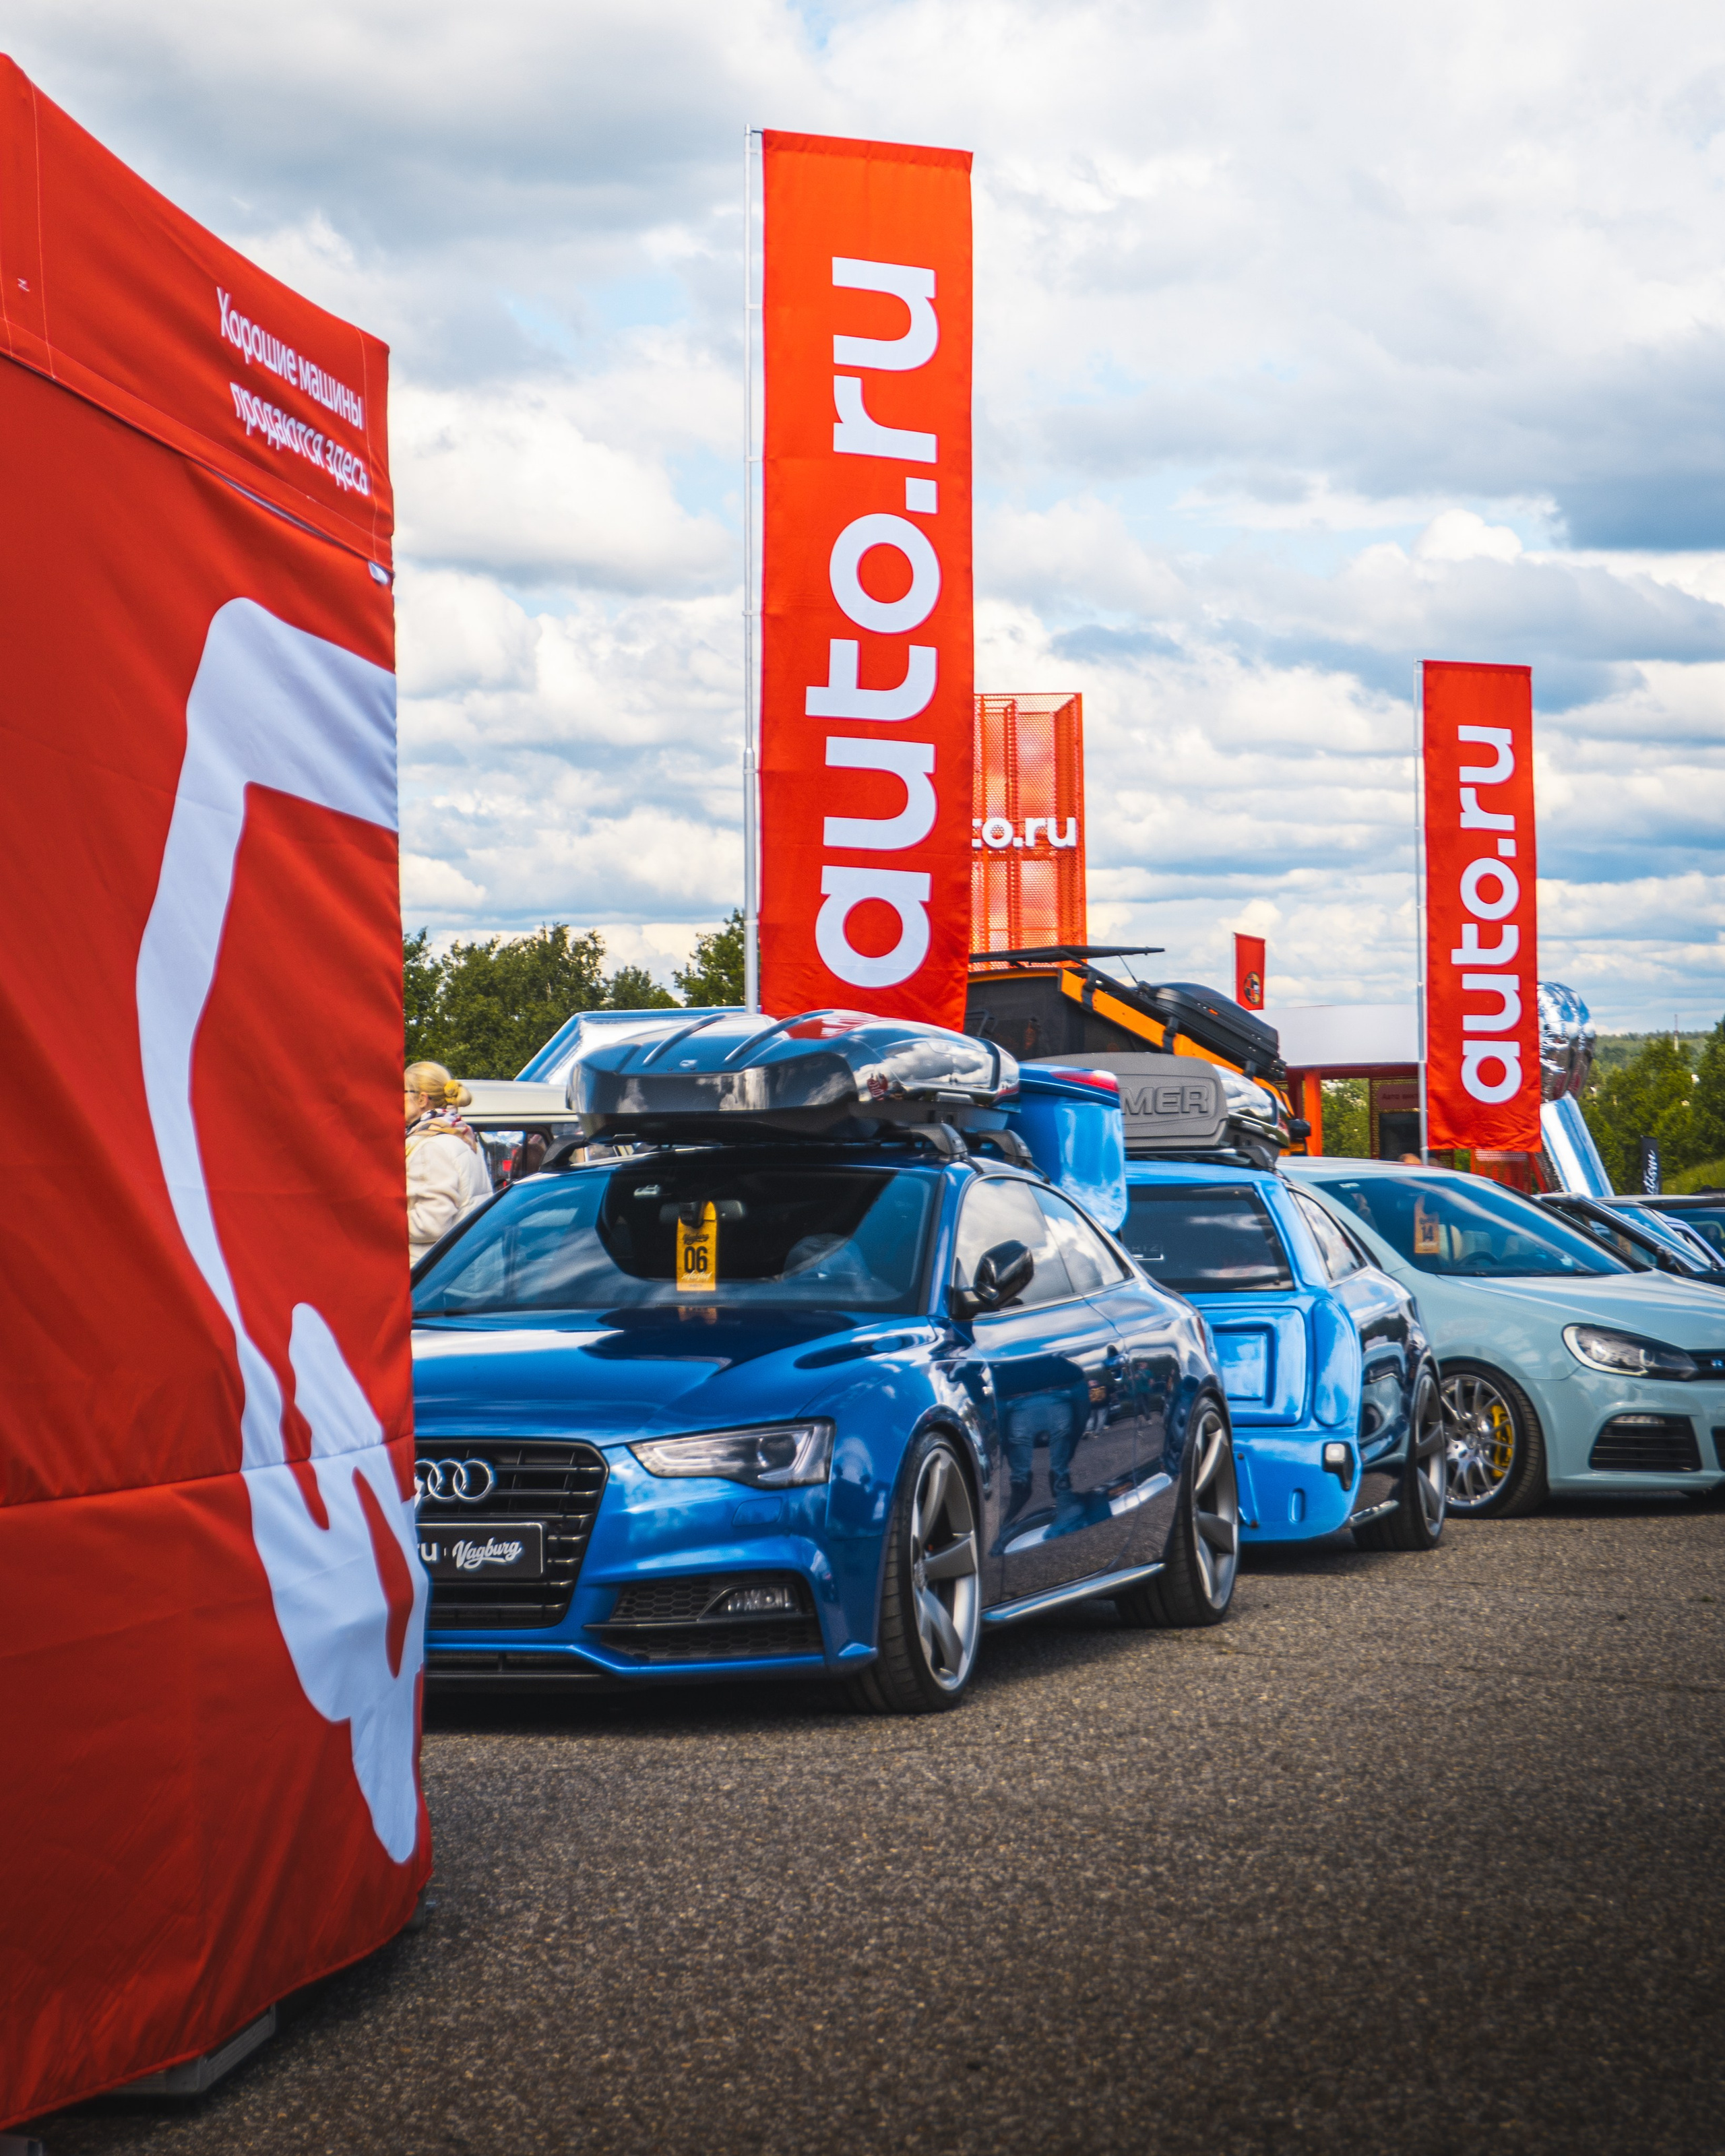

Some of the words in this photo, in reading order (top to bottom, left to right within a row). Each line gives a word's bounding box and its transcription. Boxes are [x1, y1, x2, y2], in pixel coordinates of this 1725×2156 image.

[216, 286, 297, 386] Хорошие
[298, 354, 364, 431] машины
[229, 381, 326, 470] продаются
[325, 439, 370, 496] здесь
[805, 256, 941, 990] auto.ru
[1451, 725, 1523, 1104] auto.ru
[685, 1246, 708, 1273] 06
[418, 1542, 437, 1562] u
[452, 1537, 522, 1569] Vagburg
